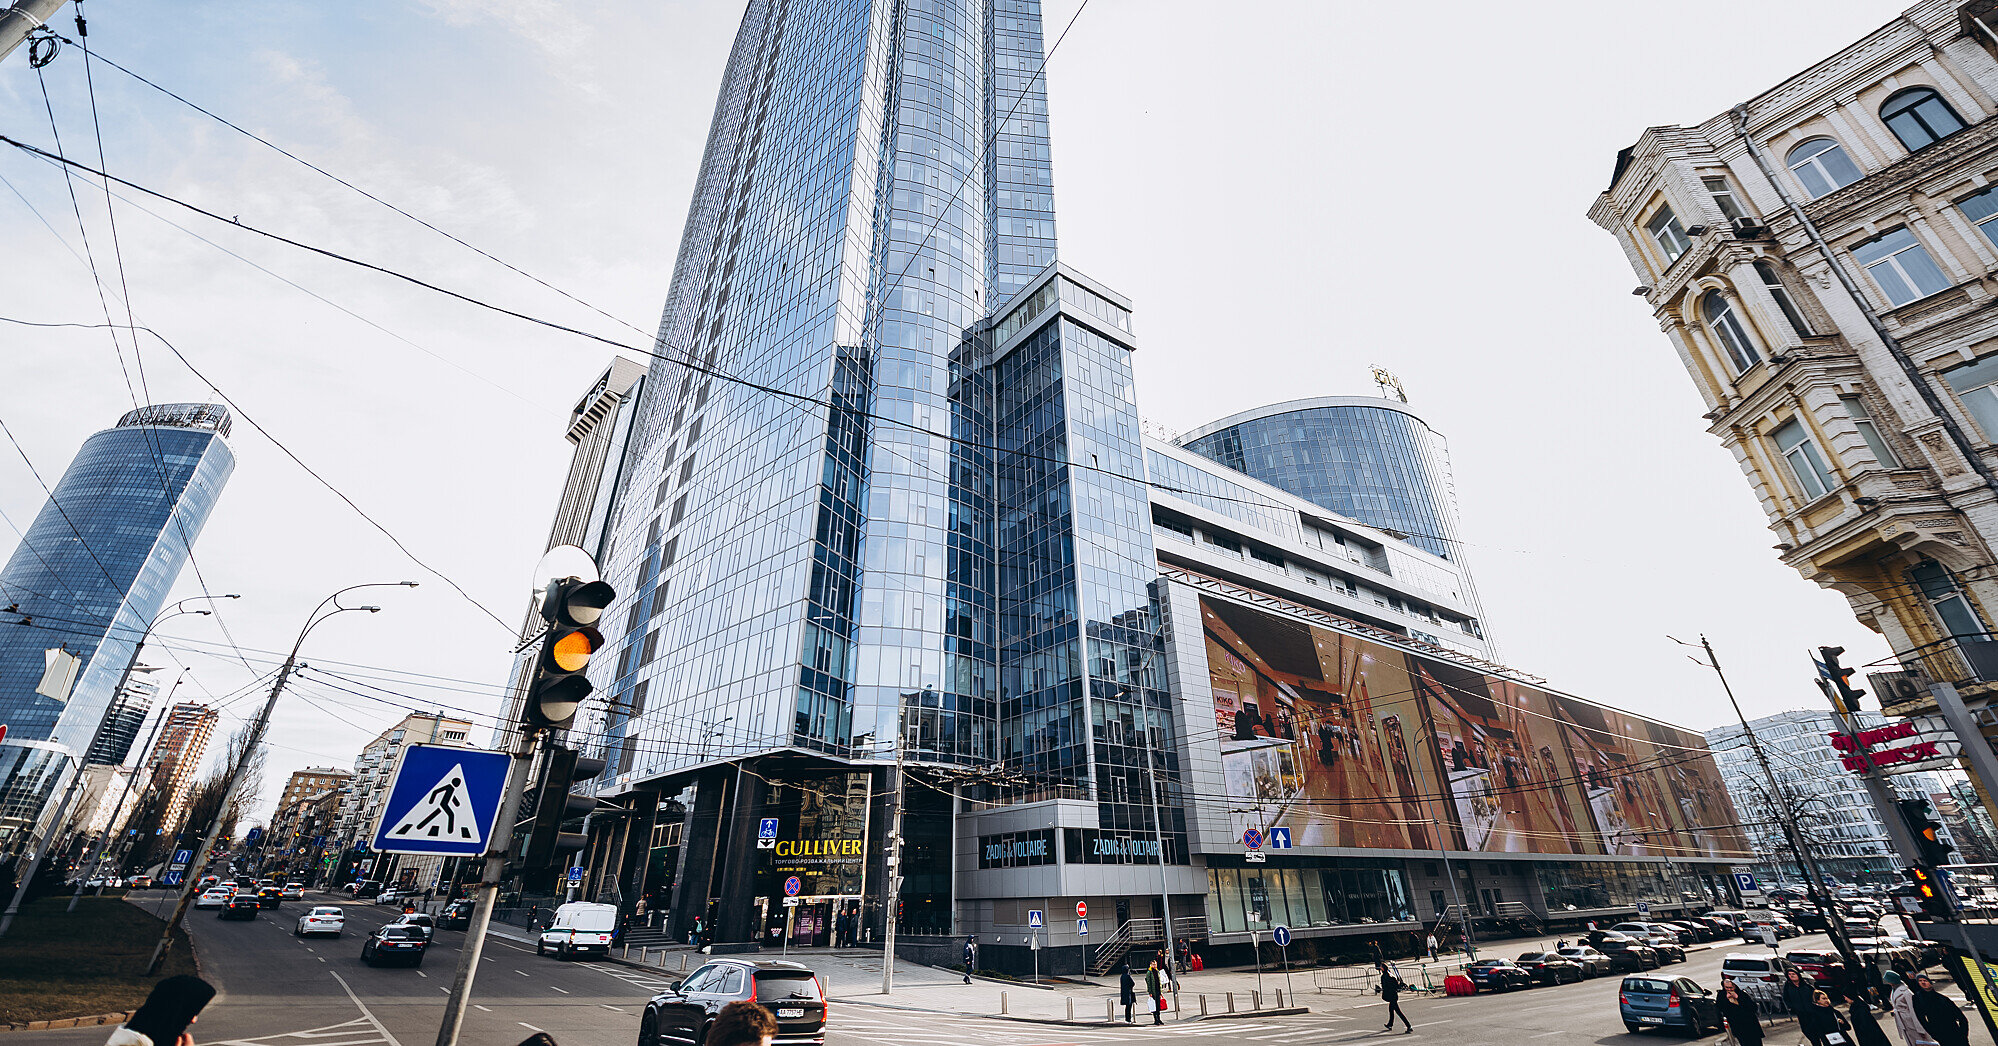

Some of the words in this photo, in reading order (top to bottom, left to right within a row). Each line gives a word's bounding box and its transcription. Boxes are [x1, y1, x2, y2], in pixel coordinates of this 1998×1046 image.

[1224, 650, 1246, 674] KIKO
[1216, 696, 1234, 706] KIKO
[775, 840, 862, 856] GULLIVER
[1013, 839, 1048, 858] VOLTAIRE
[1093, 838, 1119, 856] ZADIG
[1739, 875, 1751, 890] P
